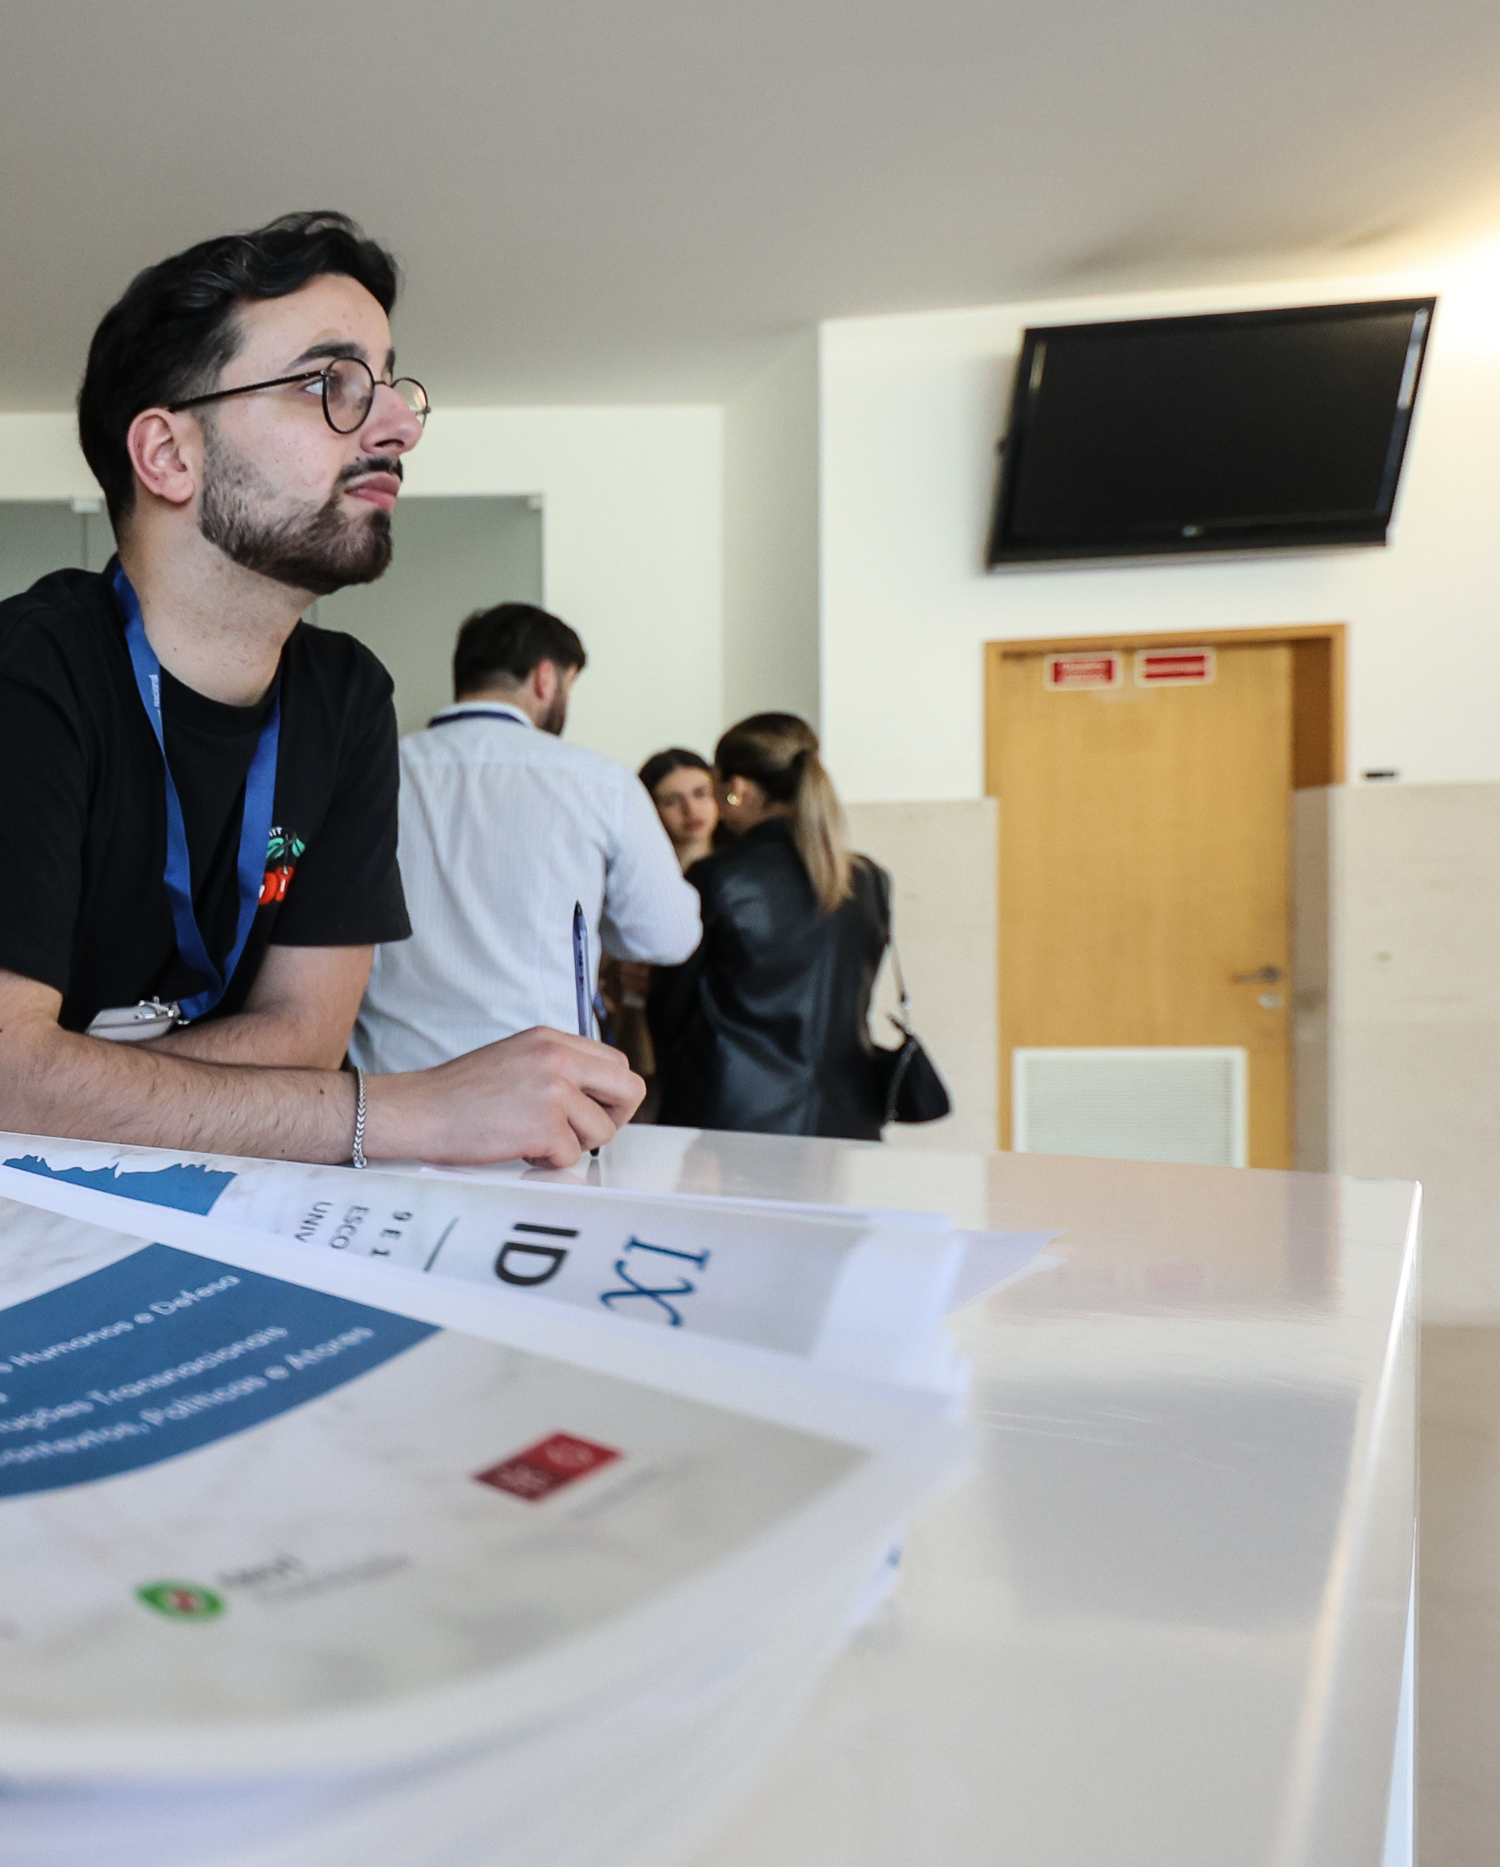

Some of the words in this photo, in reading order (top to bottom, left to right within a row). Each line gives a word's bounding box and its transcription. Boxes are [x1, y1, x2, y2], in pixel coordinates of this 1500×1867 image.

[380, 1228, 403, 1240] E
[392, 1210, 414, 1222] 9
[598, 1234, 710, 1328] IX
[8, 1320, 134, 1369] Humanos
[133, 1311, 155, 1325] e
[150, 1275, 242, 1316] Defesa
[264, 1365, 290, 1381] e
[285, 1325, 375, 1371] Atores
[87, 1326, 288, 1406] Transnacionais
